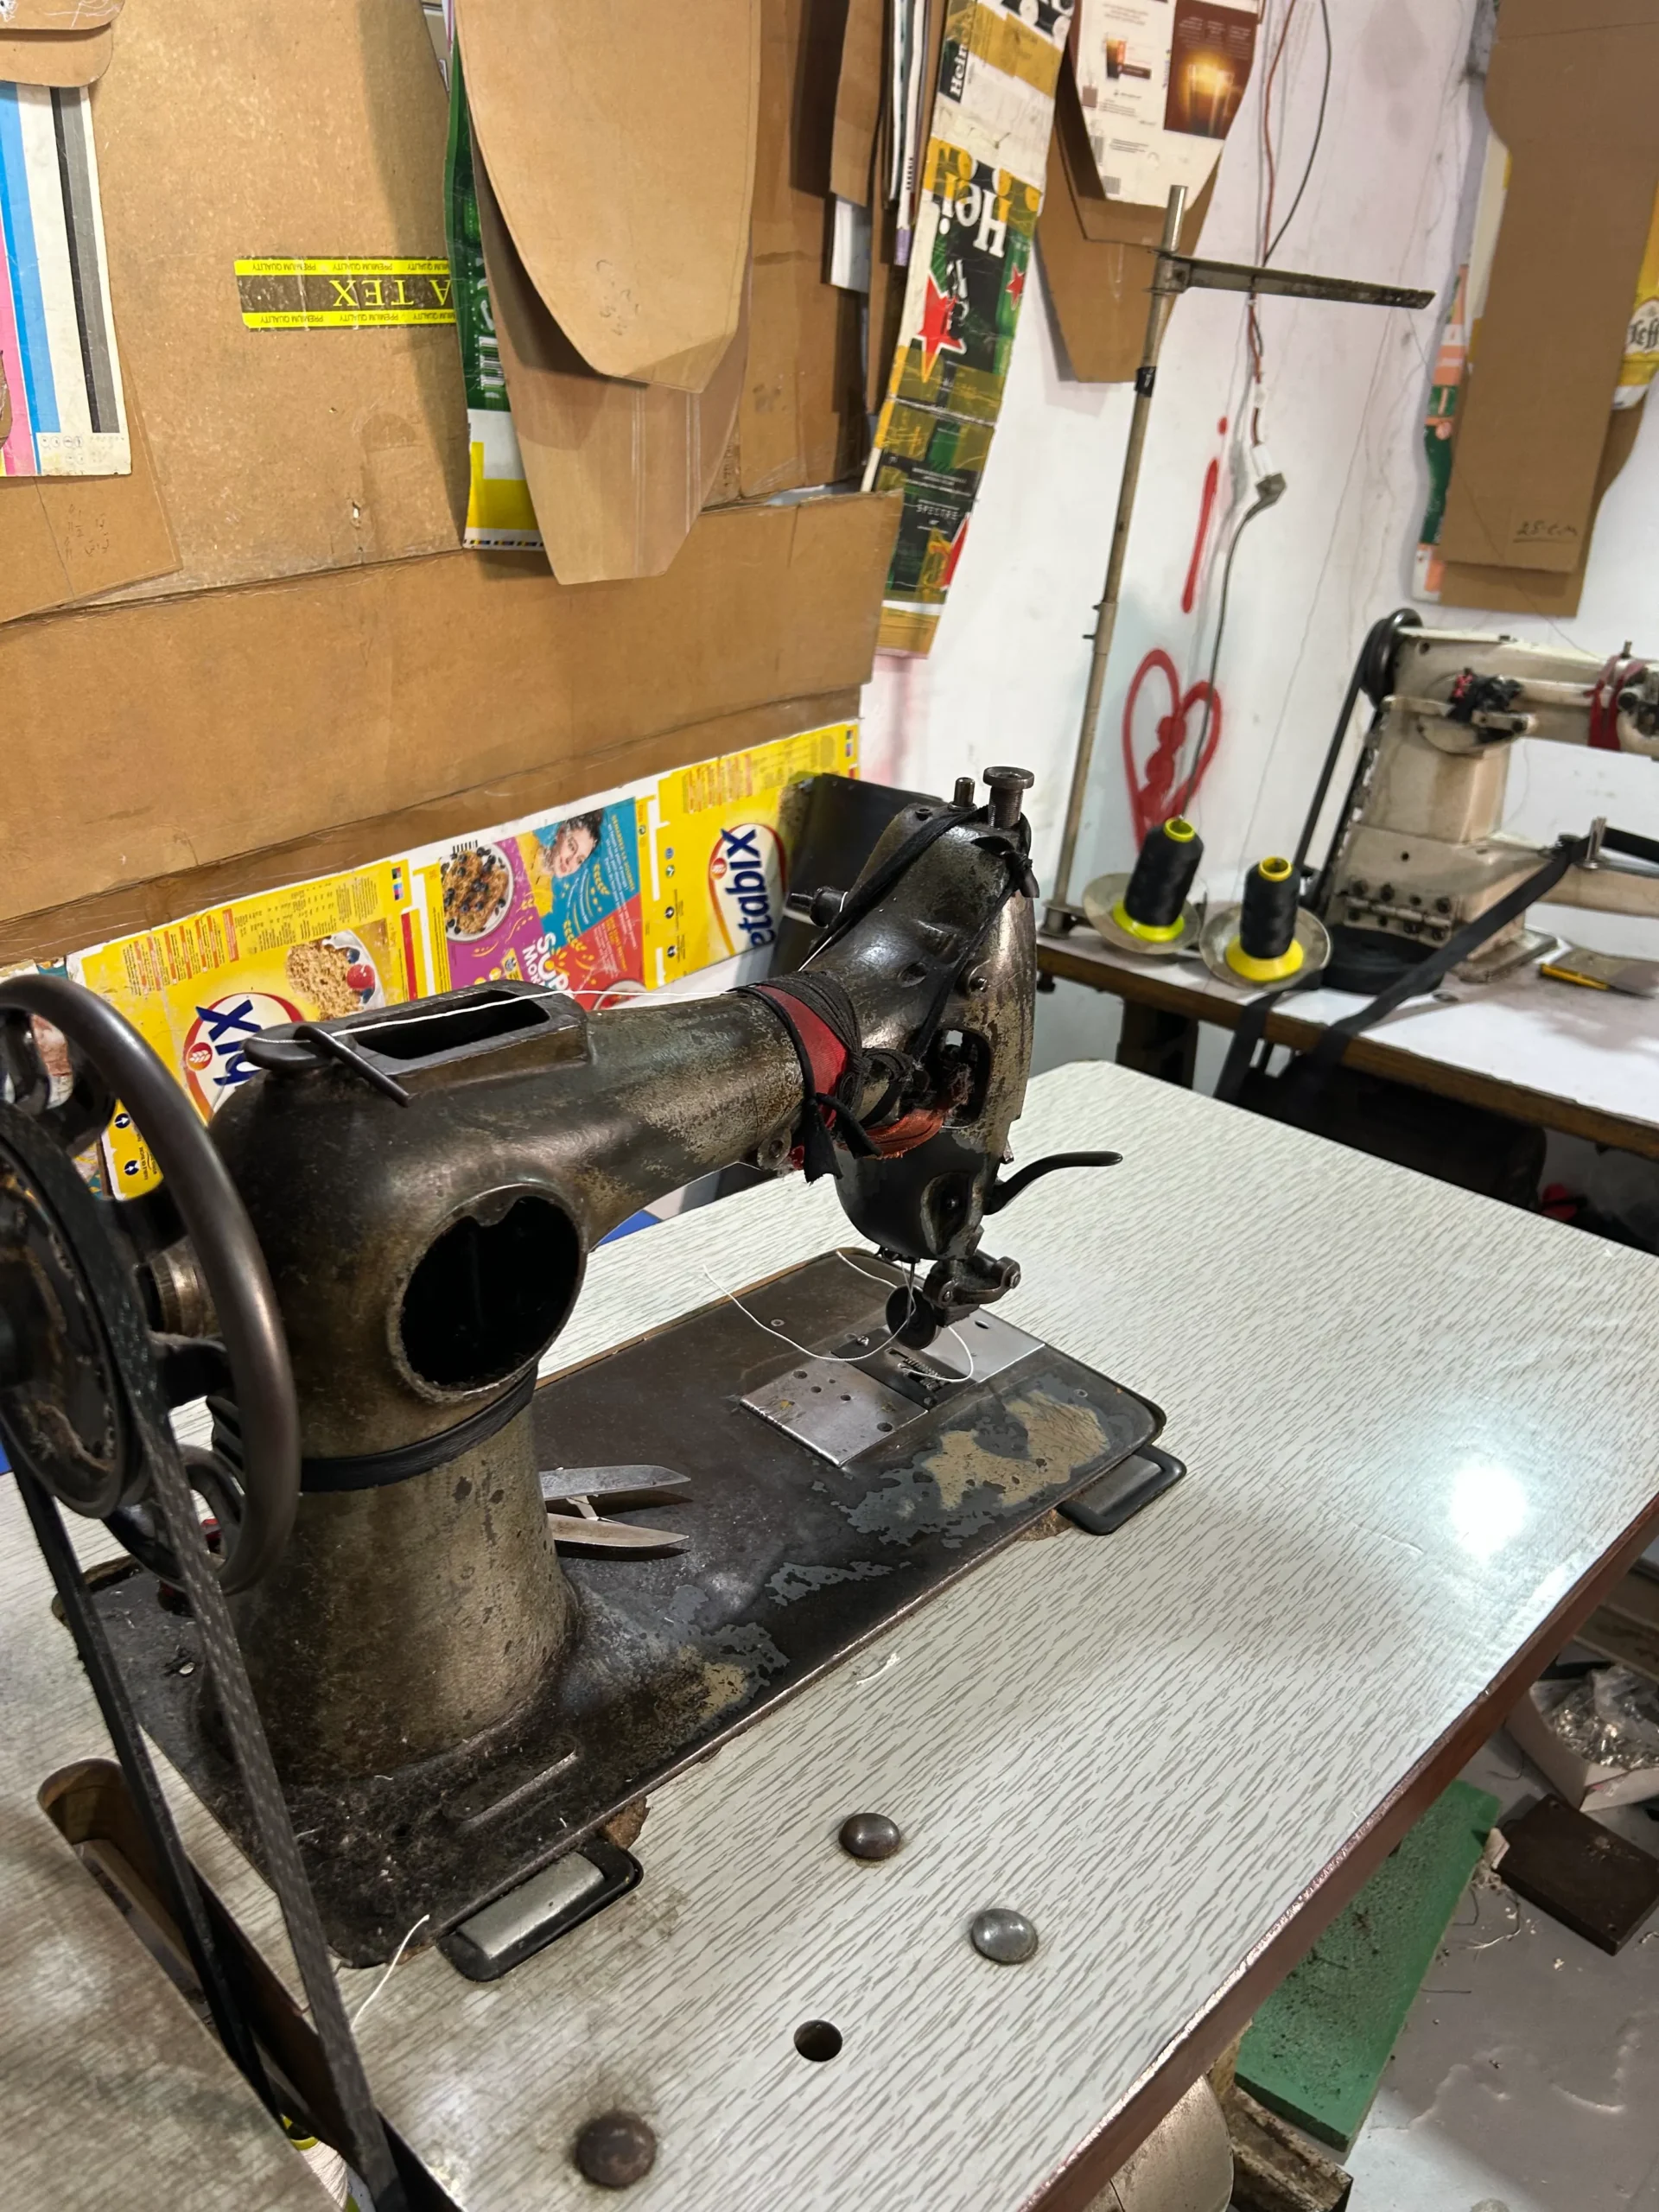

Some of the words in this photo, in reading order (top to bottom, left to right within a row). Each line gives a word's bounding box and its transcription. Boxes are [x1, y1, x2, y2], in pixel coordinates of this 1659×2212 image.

[939, 171, 1011, 257] Hei
[407, 263, 433, 271] QUALITY
[329, 280, 414, 307] TEX
[340, 314, 367, 322] QUALITY
[413, 313, 439, 321] QUALITY
